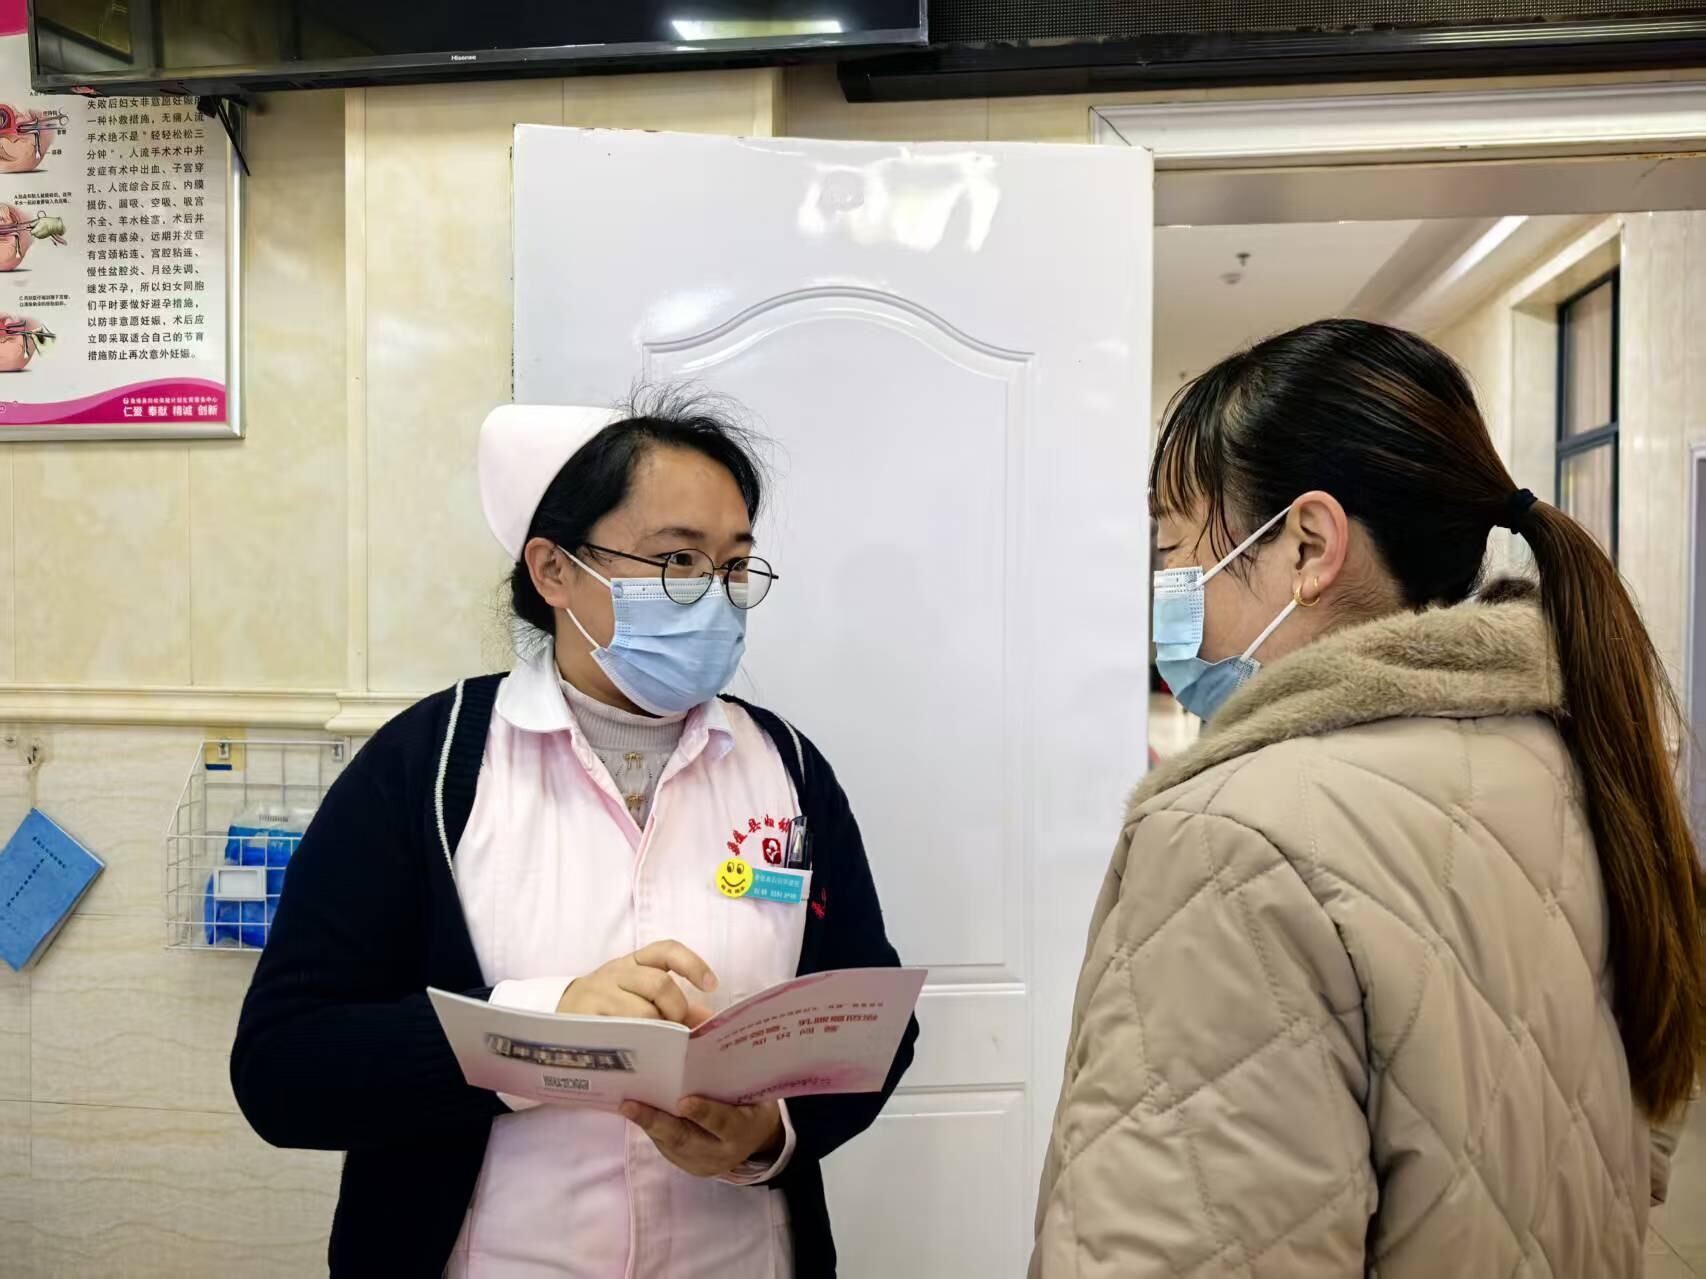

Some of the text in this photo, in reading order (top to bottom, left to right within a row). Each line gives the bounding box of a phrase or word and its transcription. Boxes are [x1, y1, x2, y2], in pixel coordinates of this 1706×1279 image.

[87, 162, 204, 176] 发症有术中出血、子宫穿
[87, 179, 204, 194] 孔、人流综合反应、内膜
[87, 196, 204, 210] 损伤、漏吸、空吸、吸宫
[87, 247, 200, 260] 有宫颈粘连、宫腔粘连、
[87, 264, 200, 277] 慢性盆腔炎、月经失调、
[87, 332, 204, 344] 立即采取适合自己的节育
[87, 348, 196, 361] 措施防止再次意外妊娠。
[123, 405, 218, 417] 仁爱 奉献 精诚 创新
